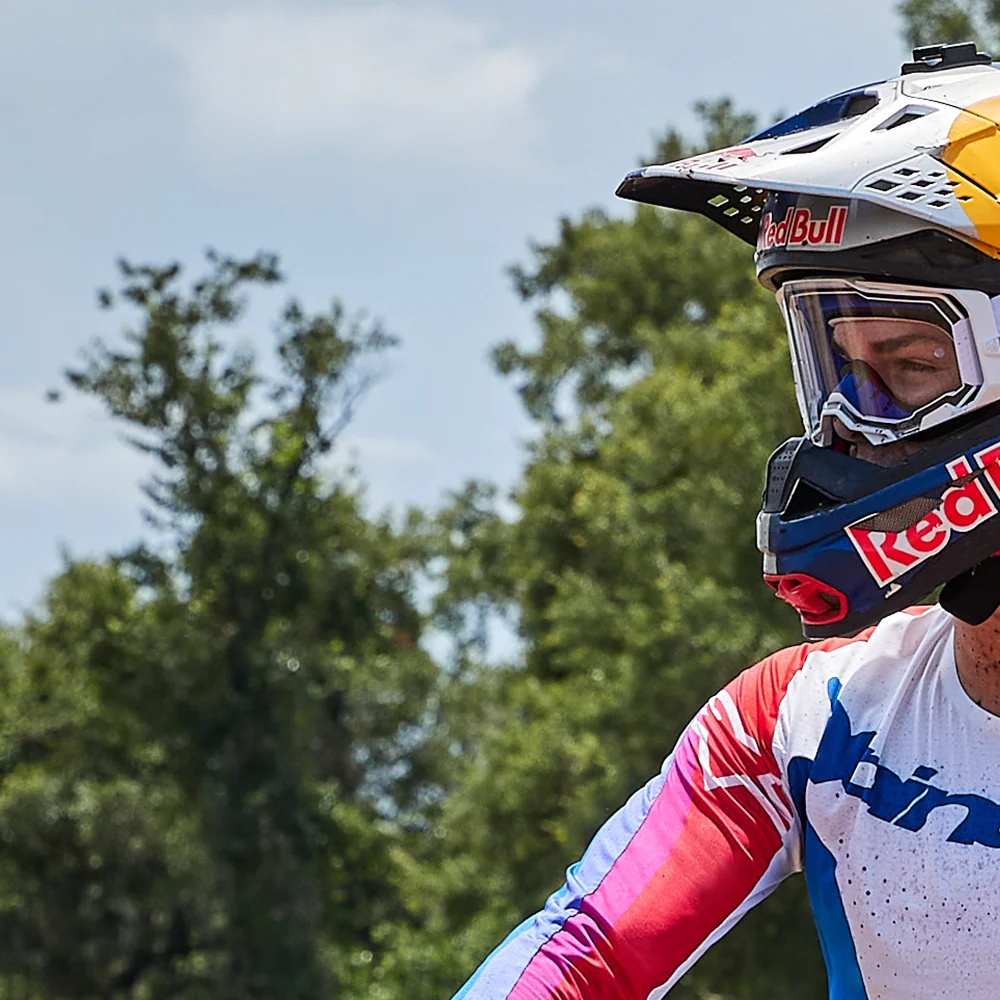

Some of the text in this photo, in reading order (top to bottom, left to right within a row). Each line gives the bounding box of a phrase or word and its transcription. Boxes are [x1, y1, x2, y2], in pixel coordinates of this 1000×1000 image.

[762, 205, 849, 249] Red Bull
[844, 455, 998, 588] Red
